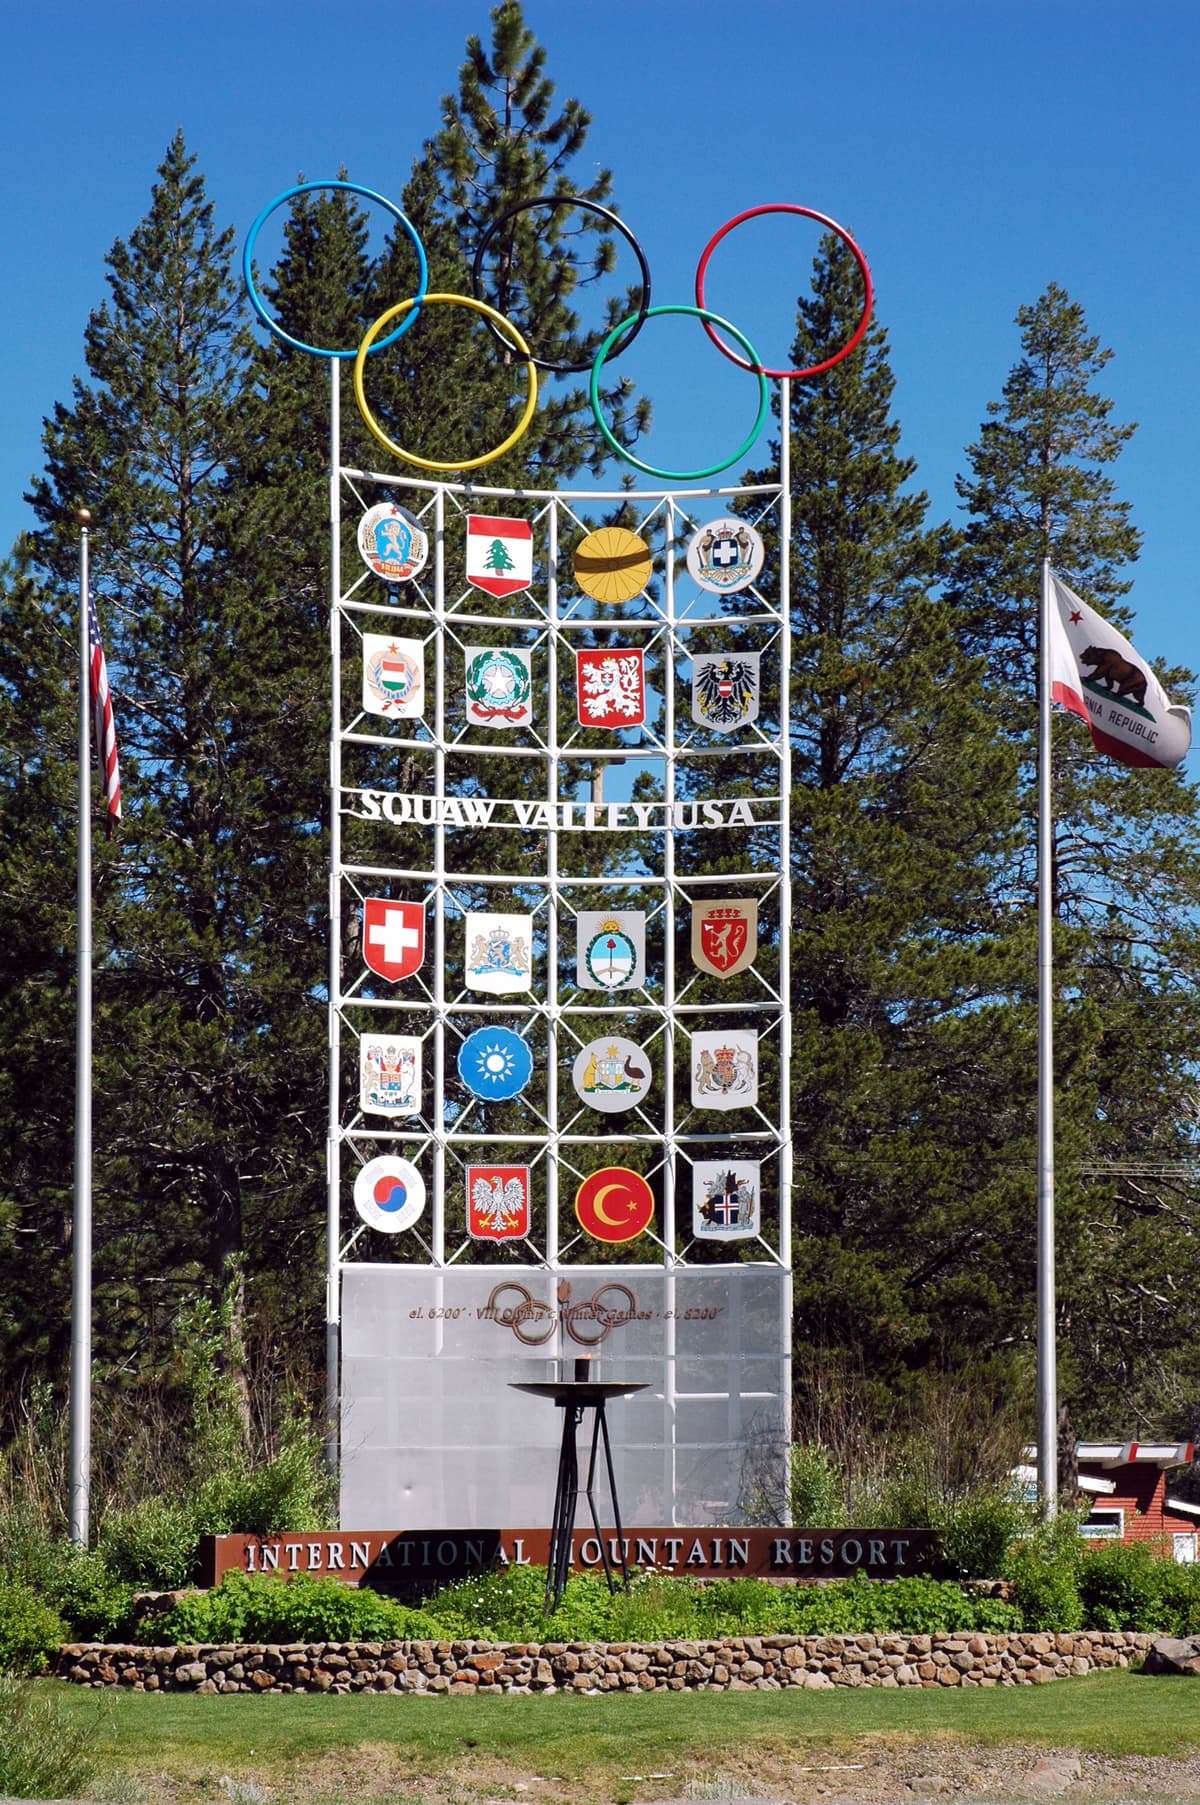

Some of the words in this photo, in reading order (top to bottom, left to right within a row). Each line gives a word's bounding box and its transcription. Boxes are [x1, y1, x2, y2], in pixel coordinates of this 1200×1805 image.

[1108, 710, 1159, 744] REPUBLIC
[361, 790, 496, 829] SQUAW
[512, 799, 655, 831] VALLEY
[672, 798, 755, 829] USA
[504, 1306, 556, 1321] Olympc
[608, 1307, 652, 1319] Games
[246, 1539, 531, 1571] INTERNATIONAL
[774, 1540, 910, 1565] RESORT
